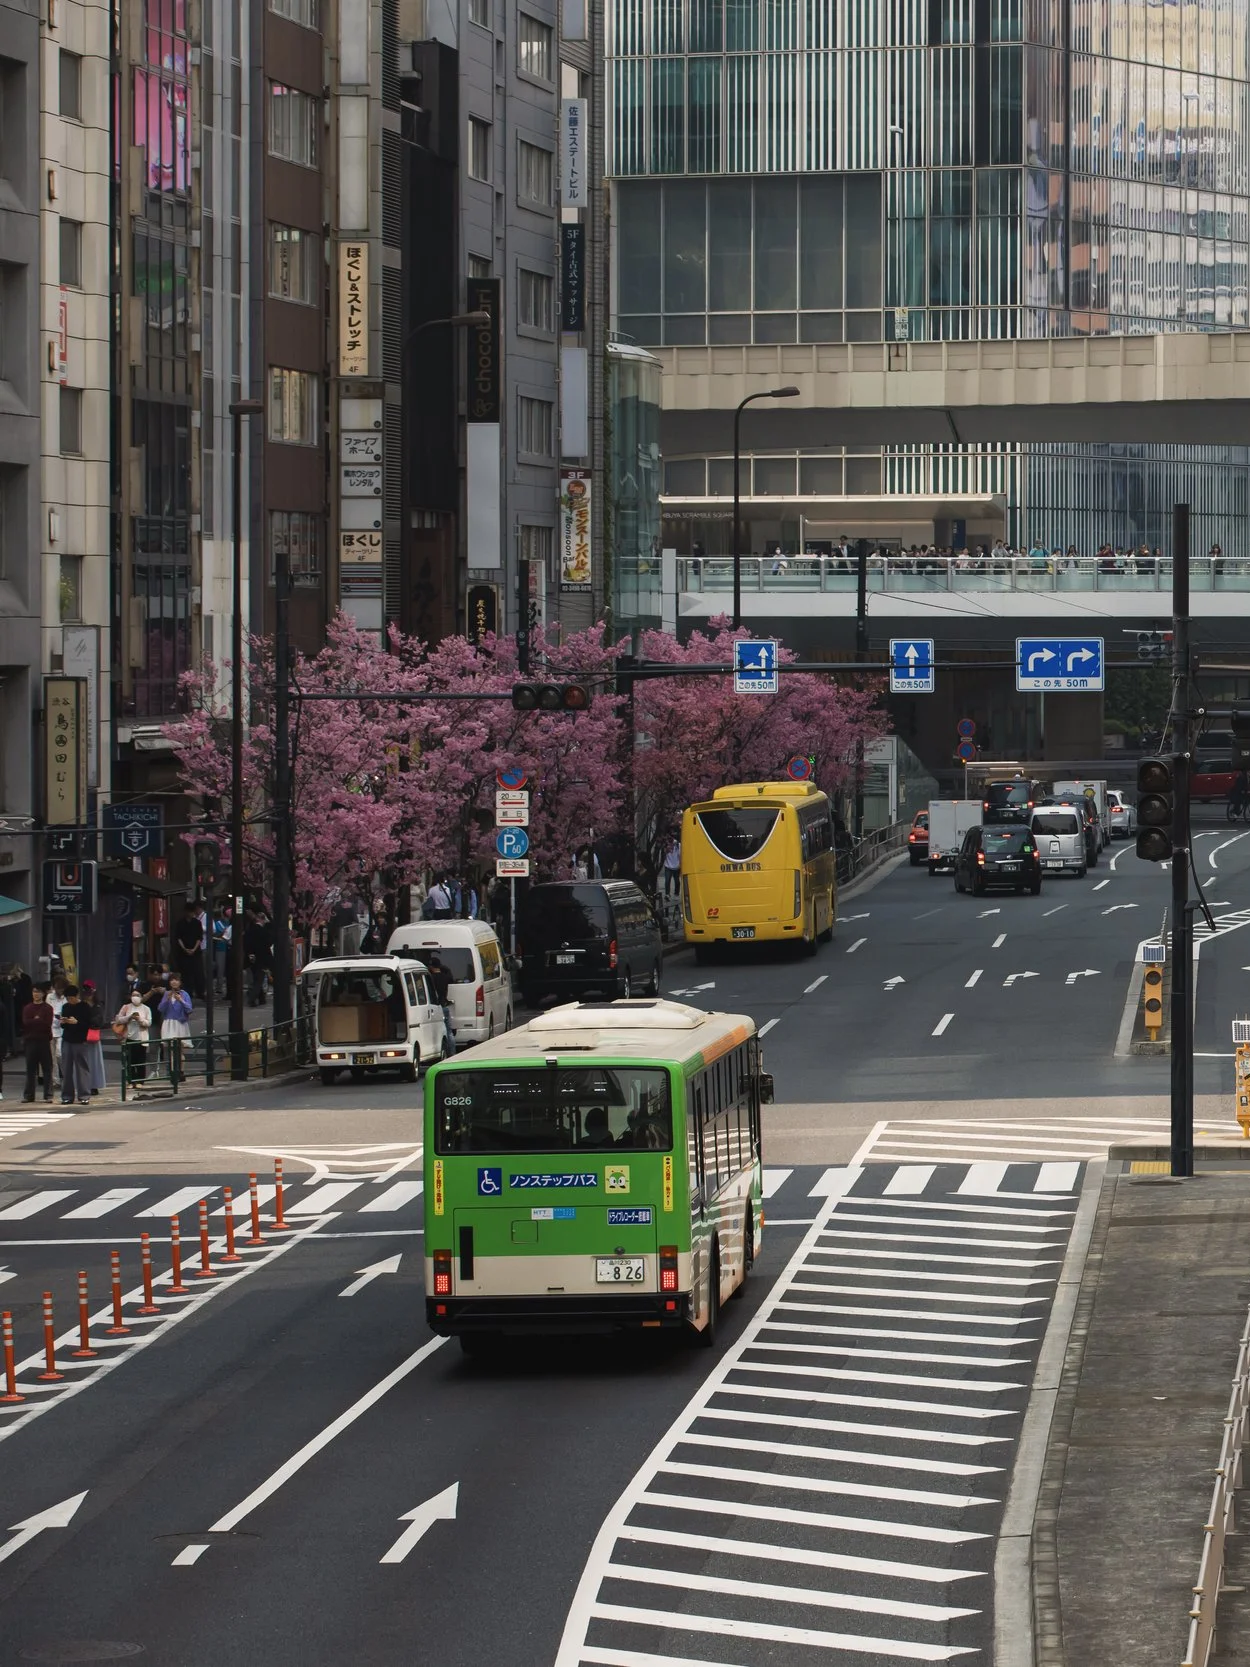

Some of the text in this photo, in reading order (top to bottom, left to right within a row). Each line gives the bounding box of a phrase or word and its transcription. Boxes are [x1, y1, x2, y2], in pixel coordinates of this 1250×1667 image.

[568, 106, 579, 200] 佐藤エステートビル
[567, 229, 579, 239] 5F
[568, 240, 579, 326] タイ古式マッサージ
[346, 247, 362, 351] ほぐし&ストレッチ
[348, 365, 359, 373] 4F
[348, 446, 374, 455] ホーム
[567, 471, 585, 479] 3F
[349, 479, 374, 487] レンタル
[342, 534, 381, 547] ほぐし
[113, 813, 159, 821] TACHIKICHI
[503, 834, 516, 854] P
[746, 862, 762, 871] BUS
[444, 1096, 472, 1106] G826
[510, 1174, 597, 1188] ノンステップバス
